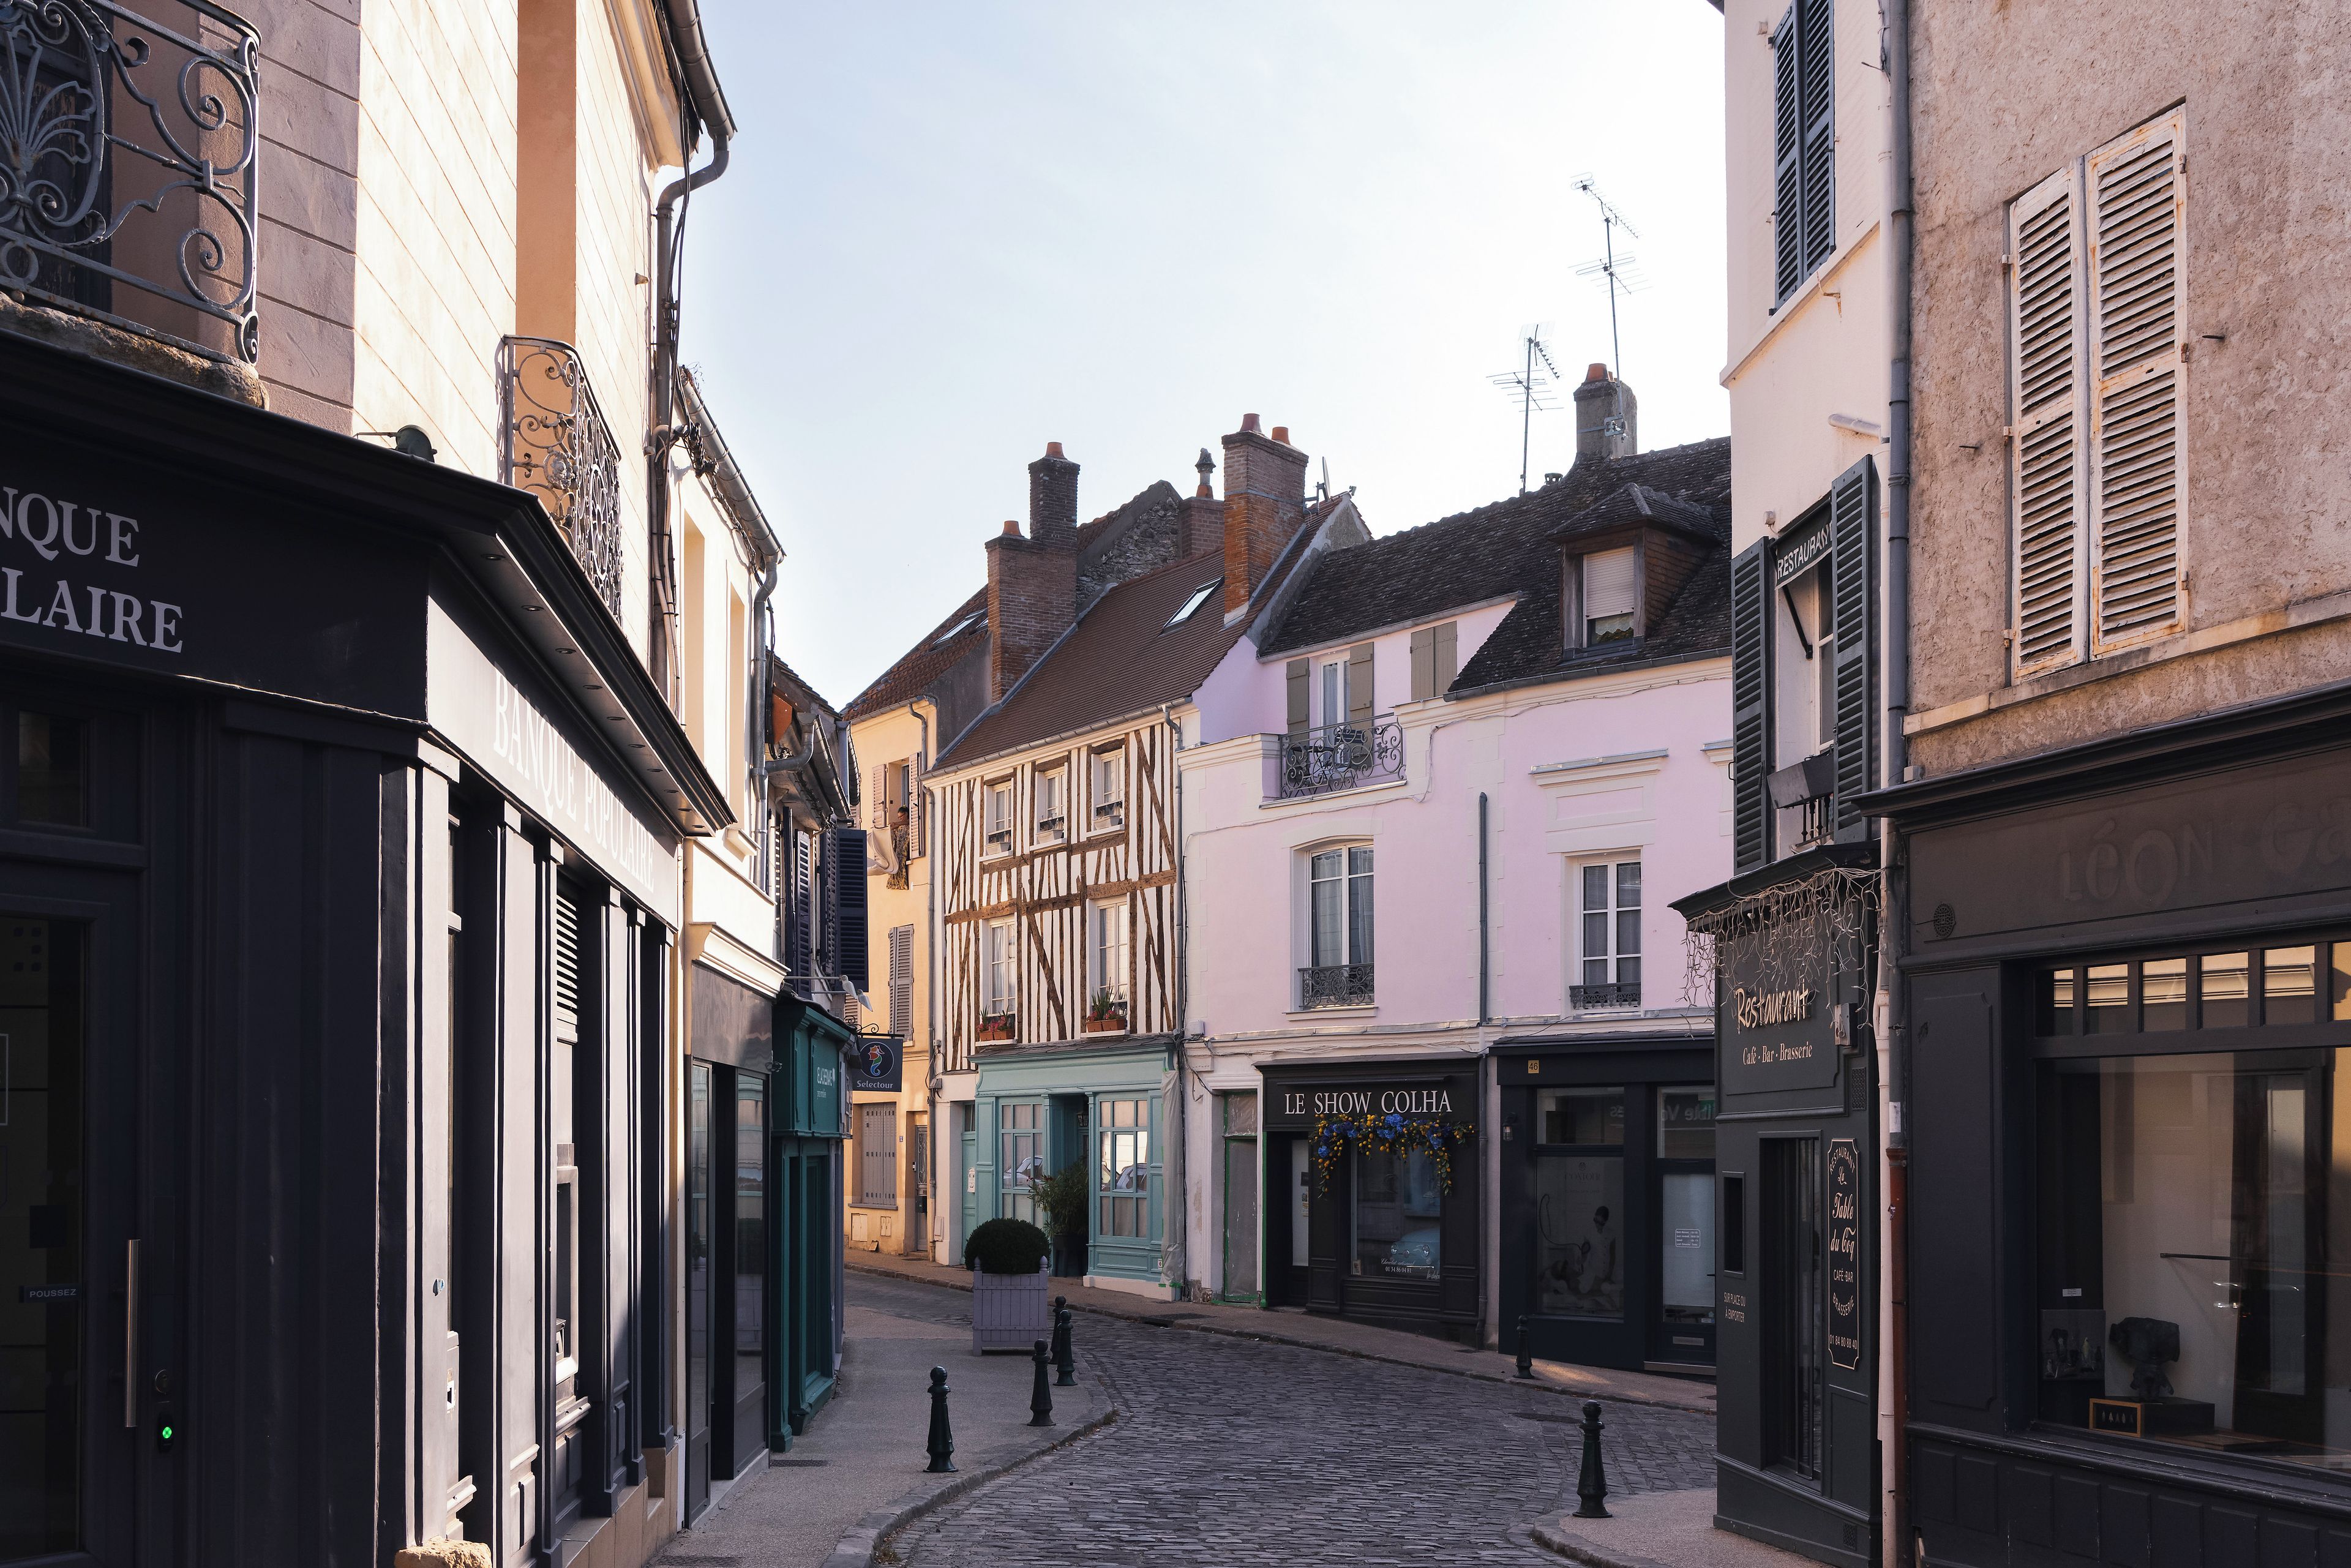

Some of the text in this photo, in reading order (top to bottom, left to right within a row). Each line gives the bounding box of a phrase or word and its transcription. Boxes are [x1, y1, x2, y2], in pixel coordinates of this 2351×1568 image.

[494, 661, 654, 893] BANQUE POPULAIRE
[1734, 978, 1808, 1030] Restaurant
[1742, 1041, 1812, 1065] Café Bar Brasserie
[857, 1079, 893, 1089] Selectour
[1284, 1090, 1453, 1114] LE SHOW COLHA
[1829, 1146, 1855, 1175] RESTAURANT
[1838, 1166, 1847, 1185] La
[1832, 1192, 1854, 1220] Table
[1830, 1227, 1856, 1262] du Coq
[1833, 1268, 1843, 1281] CAFÉ
[29, 1289, 77, 1297] POUSSEZ
[1730, 1294, 1740, 1305] PLACE
[1740, 1296, 1746, 1307] OU
[1832, 1292, 1854, 1316] BRASSERIE
[1728, 1309, 1745, 1322] EMPORTER
[1829, 1334, 1858, 1349] 01 84 80 88 40
